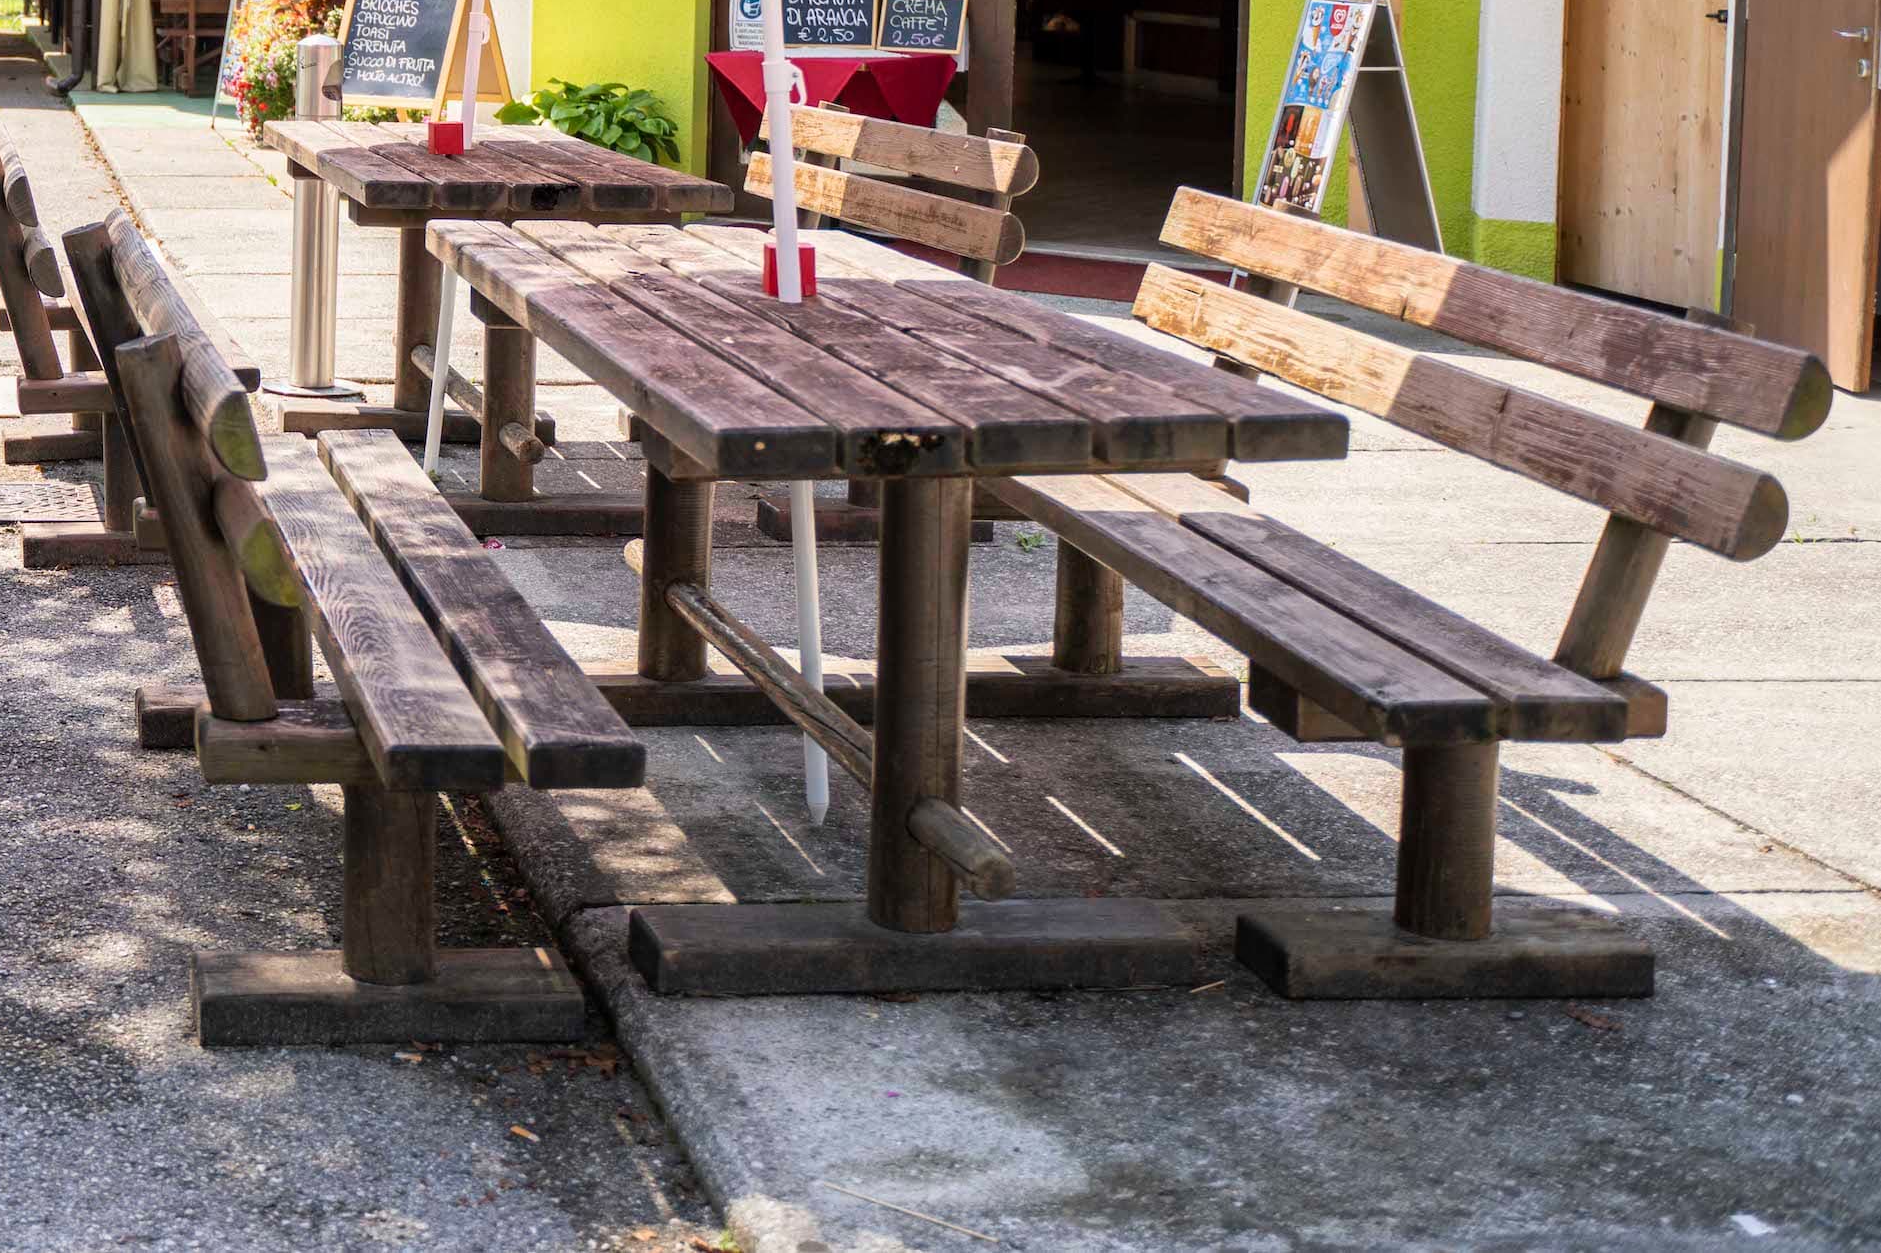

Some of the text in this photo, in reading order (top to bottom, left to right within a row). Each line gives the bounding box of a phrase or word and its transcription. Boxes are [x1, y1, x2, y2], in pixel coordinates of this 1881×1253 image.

[786, 8, 868, 27] DI ARANCIA
[355, 24, 391, 40] TOAST
[797, 27, 854, 44] € 2,50
[351, 38, 406, 53] SPREMUTA
[384, 55, 397, 68] DI
[398, 57, 435, 72] FRUTTA
[343, 67, 354, 79] E
[356, 69, 385, 82] MOLTO
